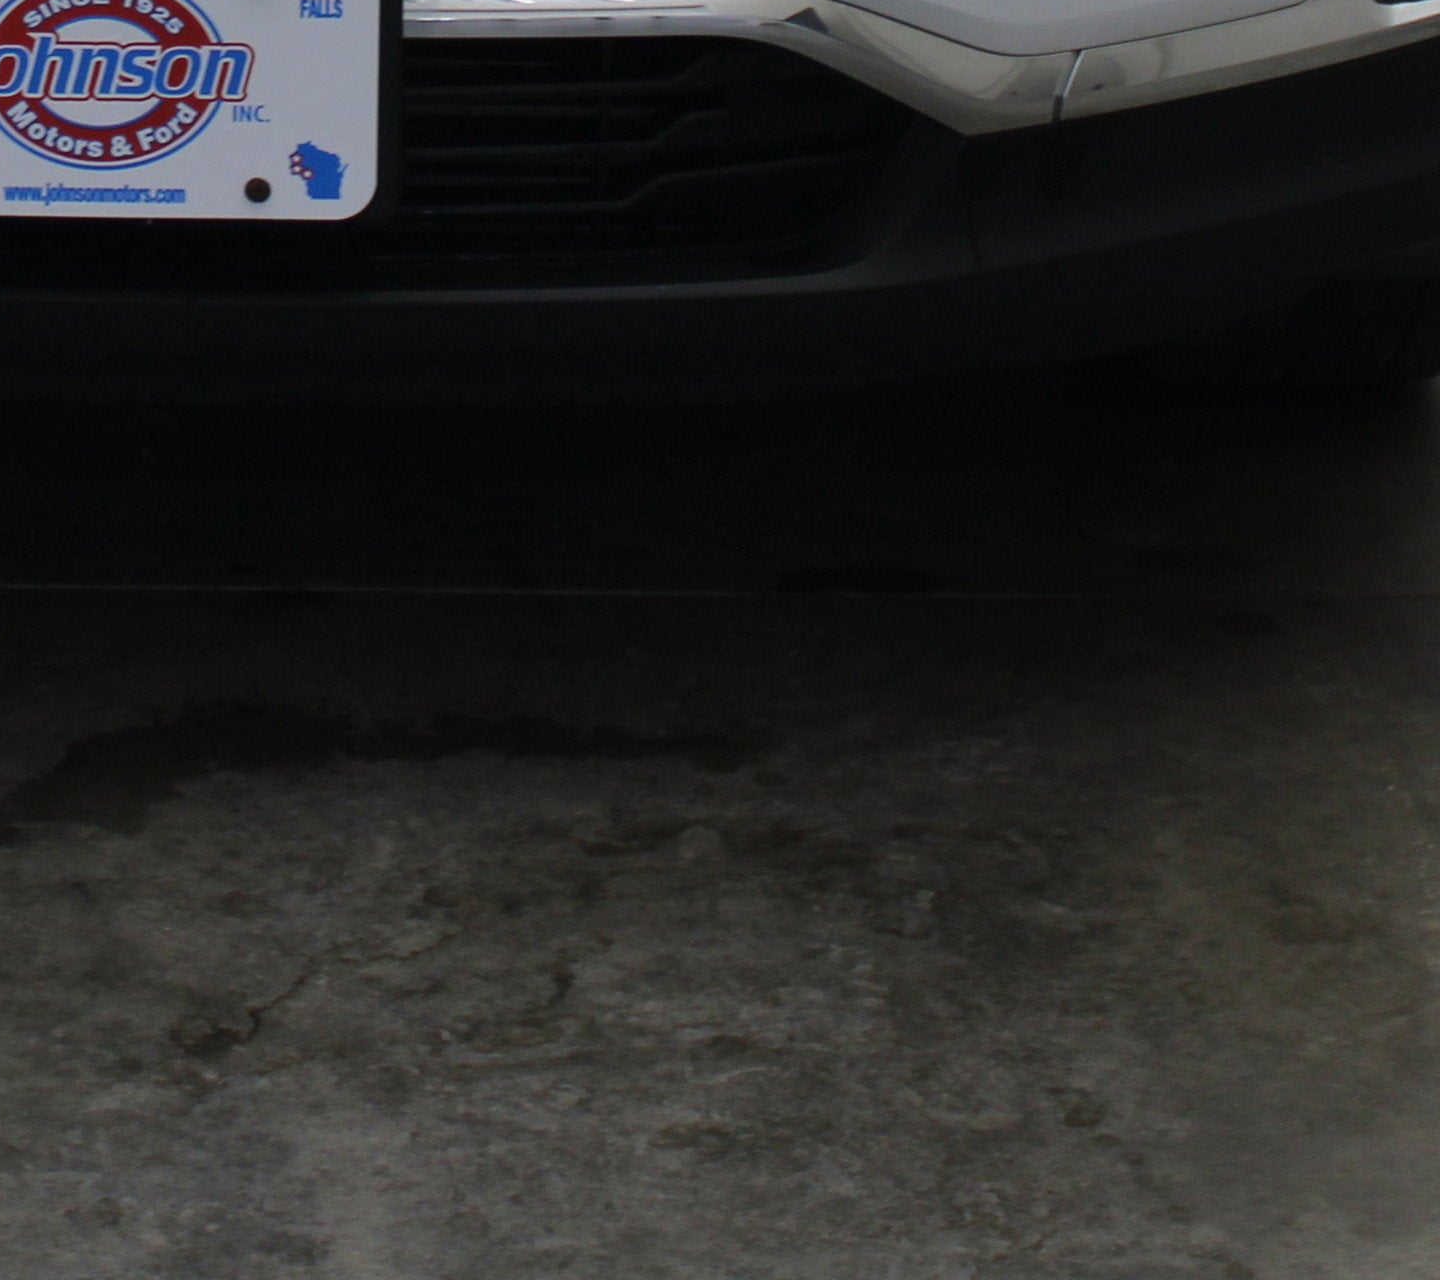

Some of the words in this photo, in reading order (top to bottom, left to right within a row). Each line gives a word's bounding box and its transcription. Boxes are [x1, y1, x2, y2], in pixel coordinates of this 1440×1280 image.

[299, 0, 343, 19] FALLS
[232, 104, 271, 123] INC.
[6, 102, 104, 158] Motors
[110, 136, 134, 157] &
[136, 102, 198, 152] Ford
[3, 183, 186, 206] www.johnsonmotors.com
